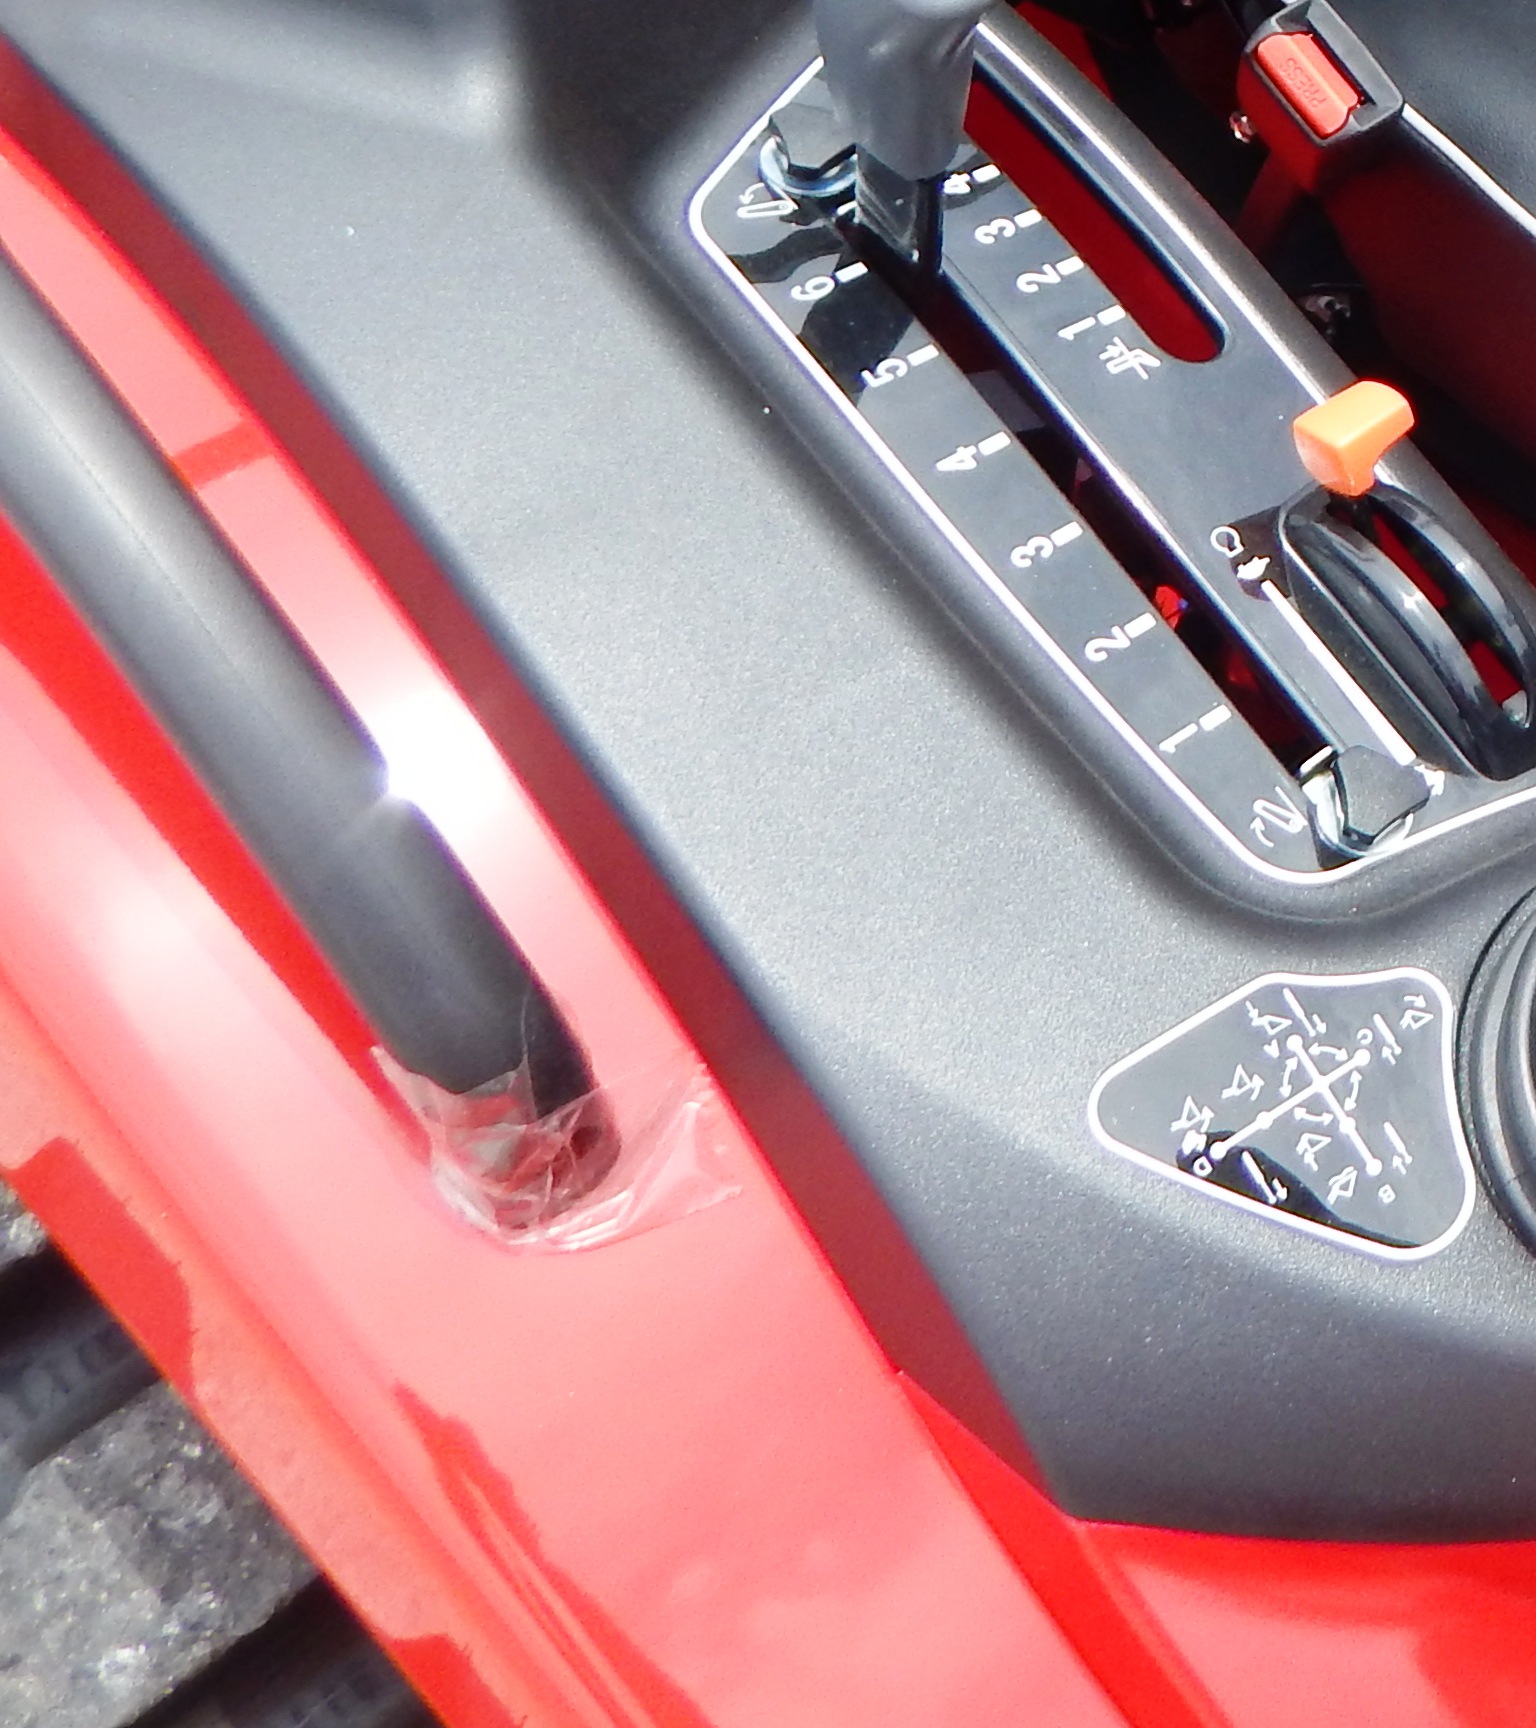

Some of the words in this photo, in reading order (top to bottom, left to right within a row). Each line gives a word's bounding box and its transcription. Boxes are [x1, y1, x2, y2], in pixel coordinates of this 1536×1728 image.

[1281, 57, 1329, 109] PRESS
[942, 173, 971, 195] 4
[975, 218, 1016, 245] 3
[791, 271, 836, 303] 6
[1016, 263, 1061, 293] 2
[1057, 316, 1096, 341] 1
[860, 356, 907, 389] 5
[935, 443, 977, 474] 4
[1011, 535, 1054, 569] 3
[1084, 628, 1130, 663] 2
[1158, 722, 1200, 755] 1
